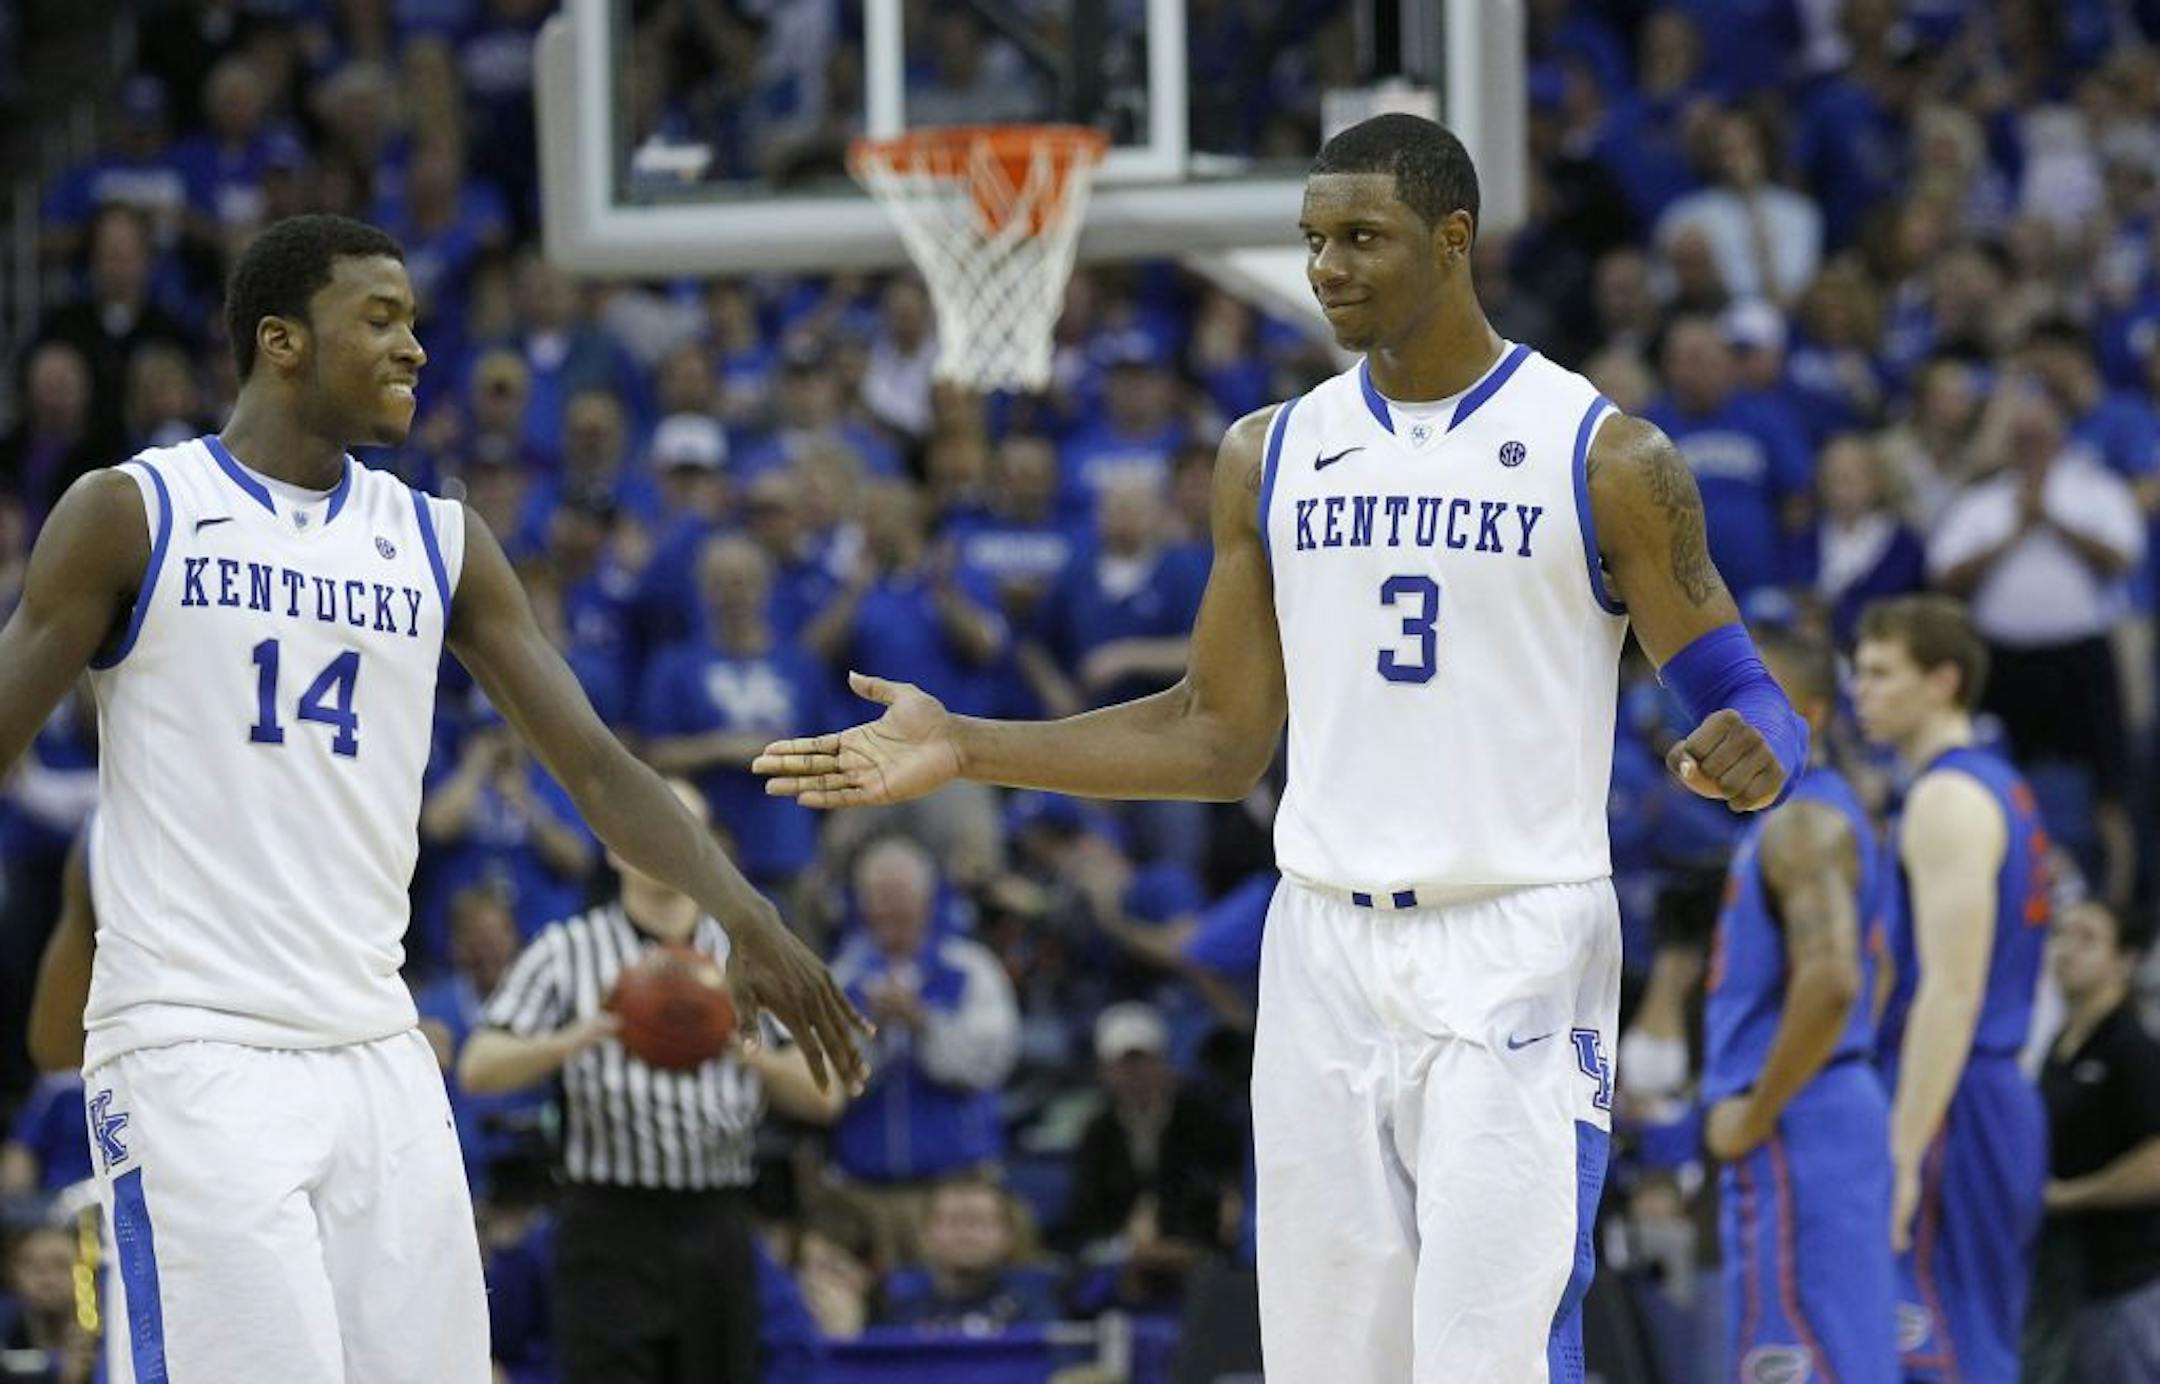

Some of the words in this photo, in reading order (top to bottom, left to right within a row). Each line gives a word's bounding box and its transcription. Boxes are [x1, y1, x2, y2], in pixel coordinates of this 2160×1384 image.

[1499, 441, 1525, 467] SEC
[1297, 496, 1543, 557] KENTUCKY
[181, 557, 422, 637] KENTUCKY
[1378, 575, 1439, 683] 3
[250, 638, 361, 757] 14
